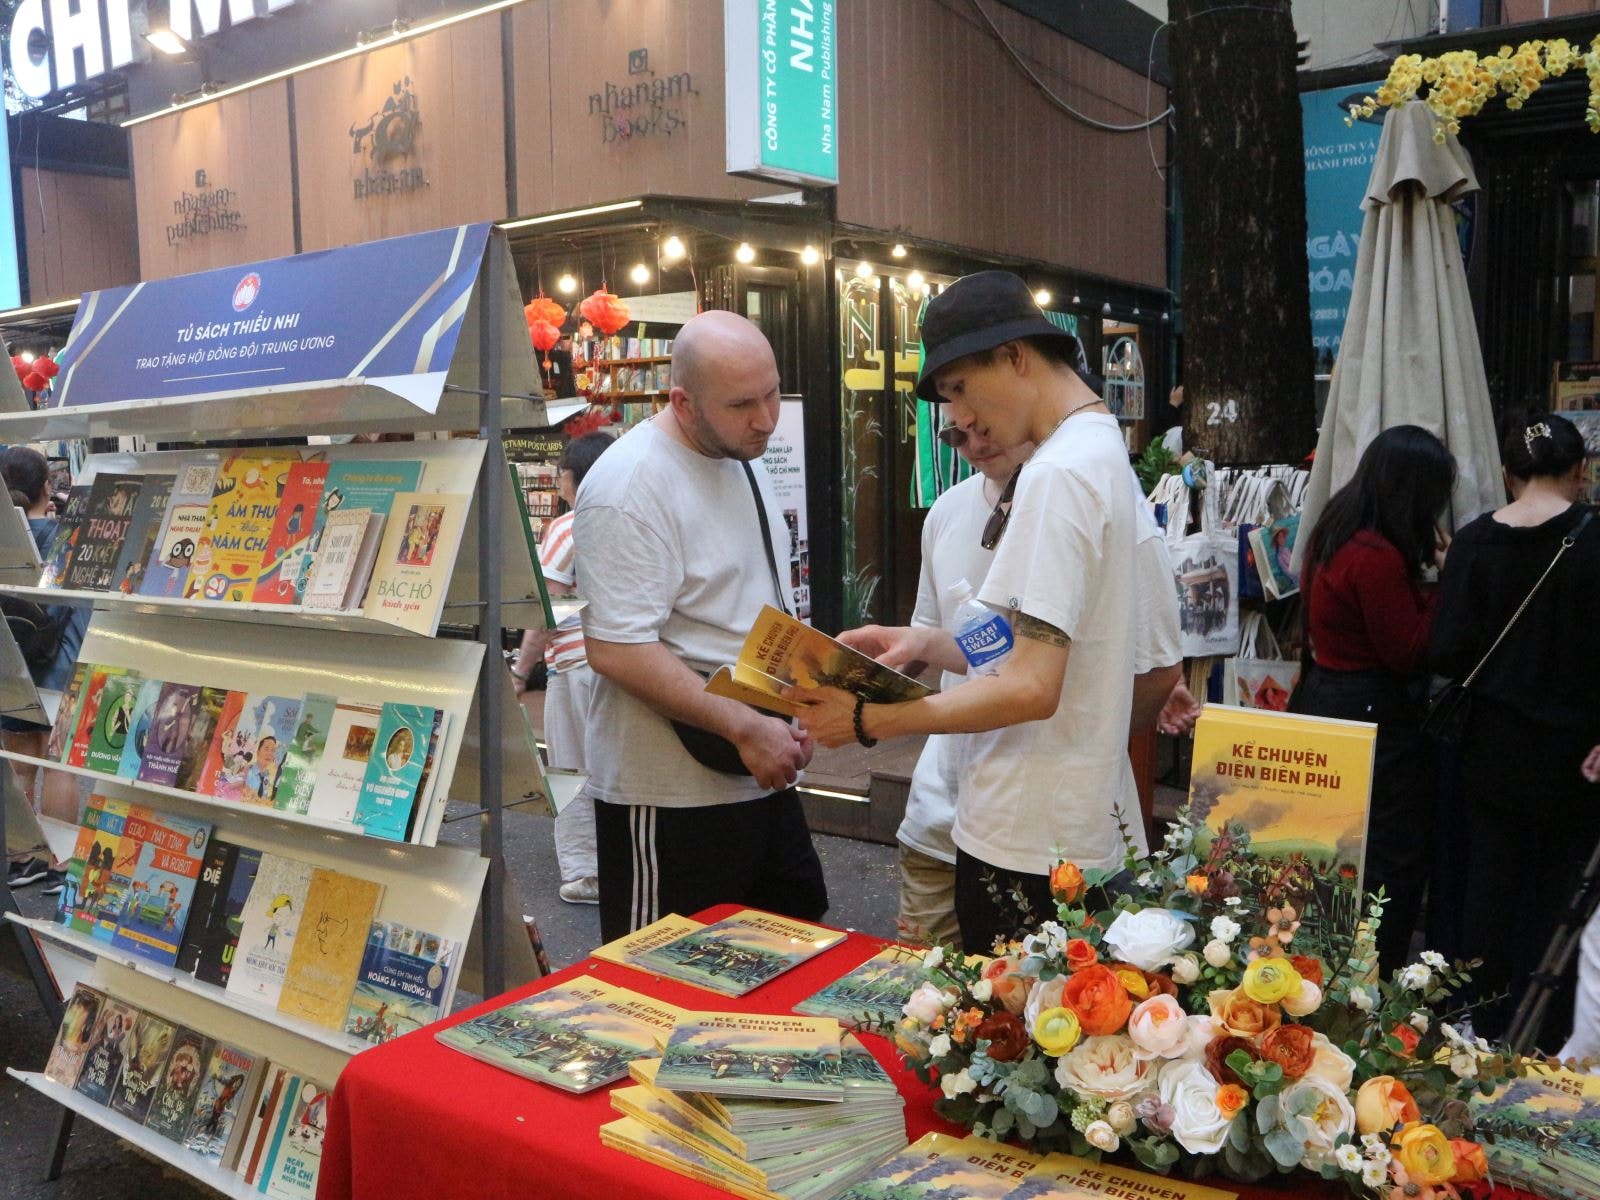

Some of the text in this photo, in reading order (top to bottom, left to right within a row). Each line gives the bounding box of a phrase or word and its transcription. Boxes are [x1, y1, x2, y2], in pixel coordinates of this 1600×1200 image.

[766, 76, 777, 97] TY
[821, 2, 832, 154] Nha Nam Publishing
[766, 102, 778, 151] CÔNG
[177, 311, 300, 343] TỦ SÁCH THIẾU NHI
[136, 356, 159, 370] TRAO
[162, 354, 186, 369] TẶNG
[188, 350, 204, 365] HỘI
[240, 344, 259, 359] ĐỘI
[262, 340, 297, 355] TRUNG
[301, 336, 334, 350] ƯƠNG
[1206, 398, 1238, 425] 24
[78, 544, 93, 561] 20
[962, 624, 998, 646] POCARI
[966, 632, 998, 653] SWEAT
[1258, 747, 1328, 768] CHUYỆN
[1216, 760, 1256, 780] ĐIỆN
[1260, 765, 1300, 785] BIÊN
